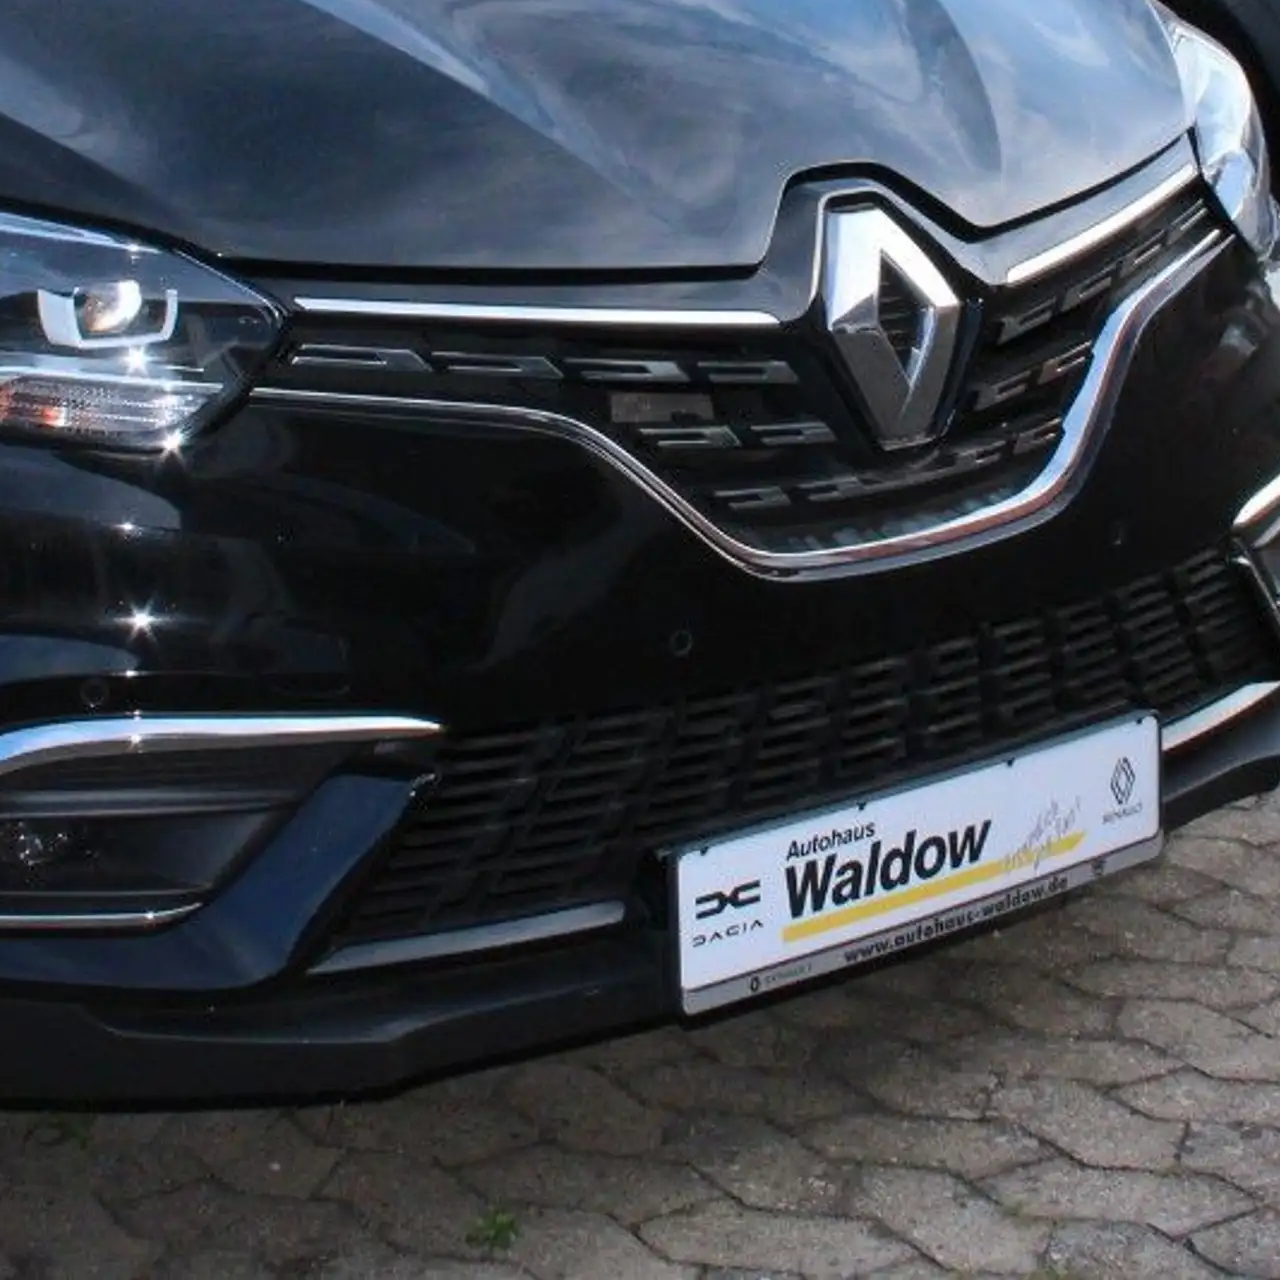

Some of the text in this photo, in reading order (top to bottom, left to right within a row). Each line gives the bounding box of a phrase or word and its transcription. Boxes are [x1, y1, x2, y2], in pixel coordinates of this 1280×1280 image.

[786, 821, 876, 861] Autohaus
[785, 819, 992, 919] Waldow
[692, 919, 764, 948] DACIA
